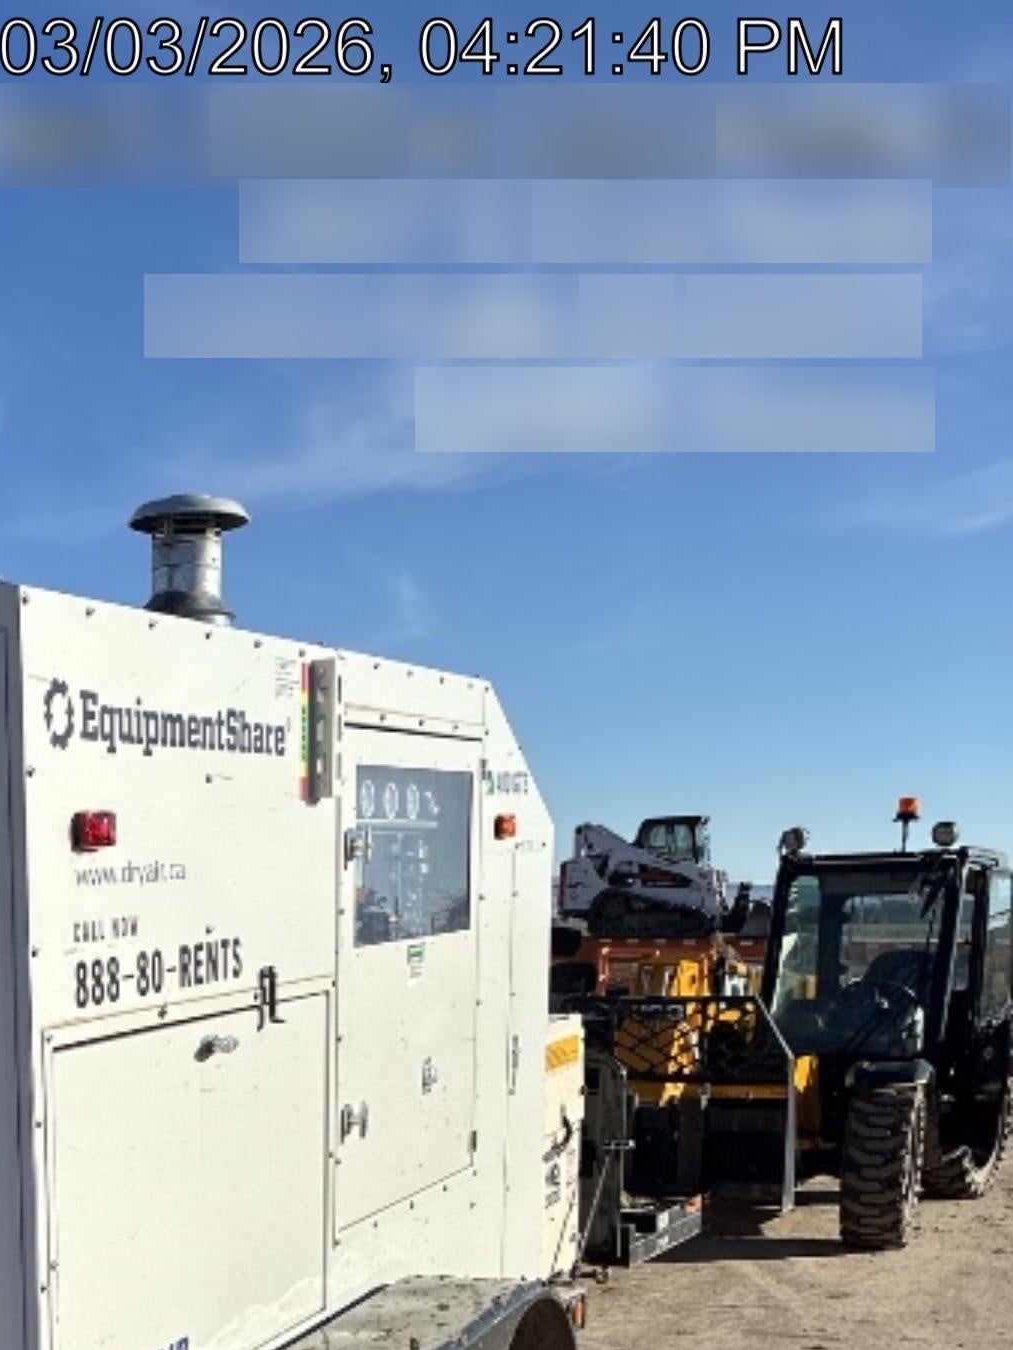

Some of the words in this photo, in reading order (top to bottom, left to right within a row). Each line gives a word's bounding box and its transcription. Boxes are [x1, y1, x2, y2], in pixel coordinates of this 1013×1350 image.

[79, 689, 286, 757] EquipmentShare
[73, 918, 106, 943] CALL
[111, 915, 138, 938] NOW
[75, 936, 244, 1010] 888-80-RENTS
